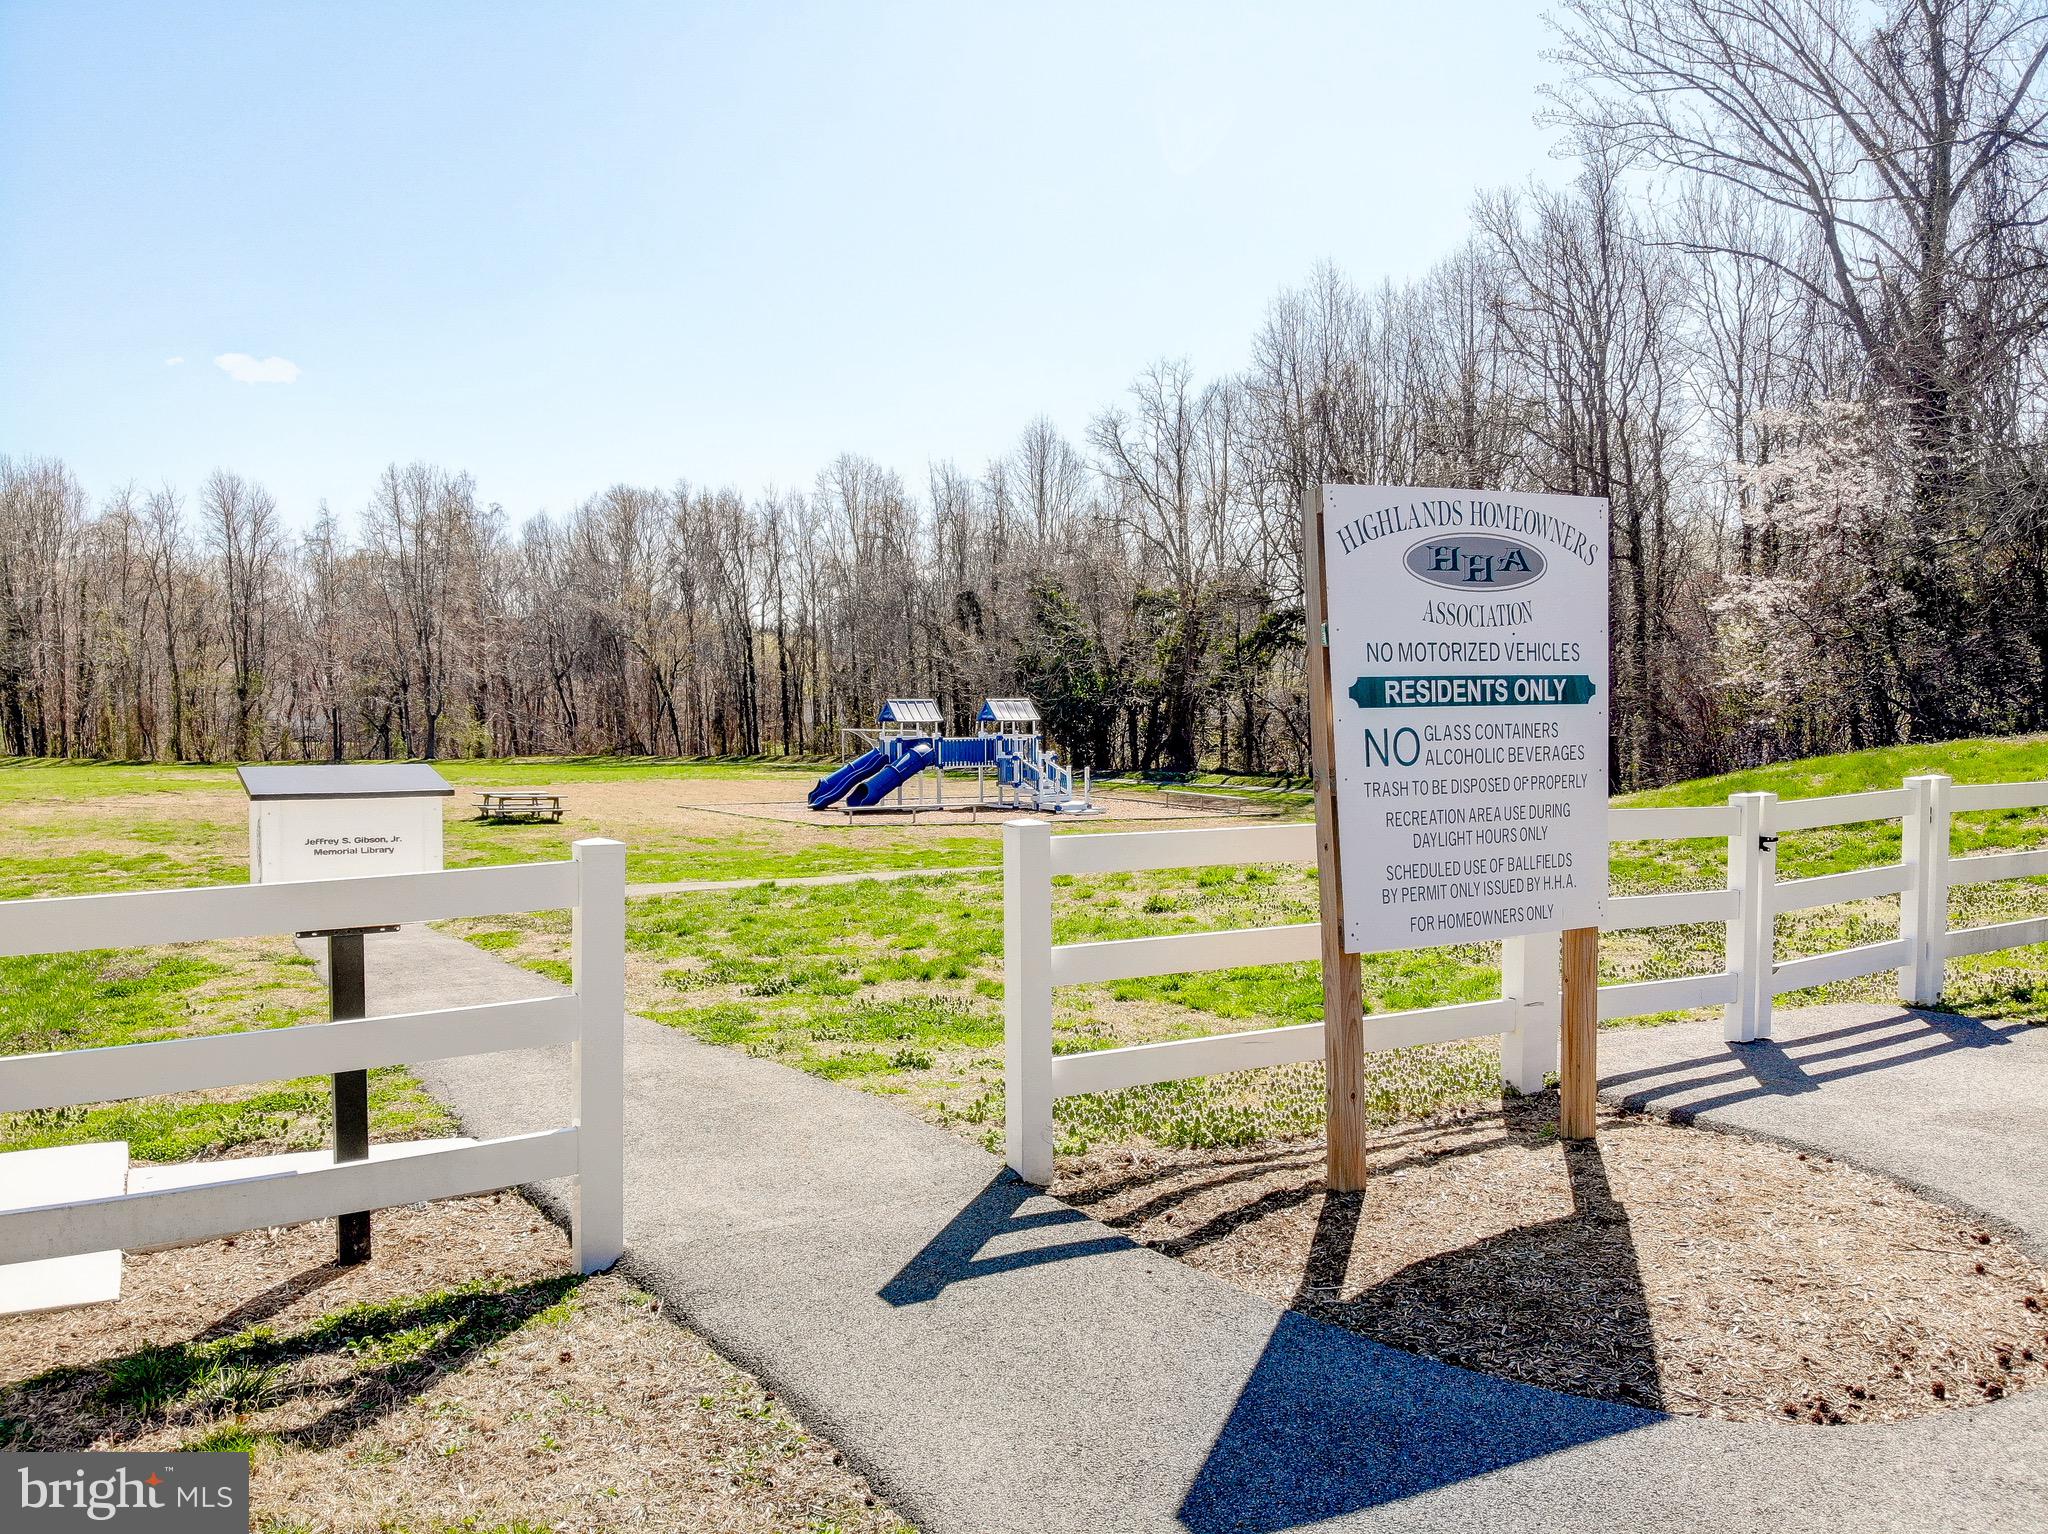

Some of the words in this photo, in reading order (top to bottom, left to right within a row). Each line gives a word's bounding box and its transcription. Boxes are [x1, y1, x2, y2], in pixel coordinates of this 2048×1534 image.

[1336, 500, 1463, 555] HIGHLANDS
[1471, 501, 1599, 566] HOMEOWNERS
[1423, 600, 1533, 627] ASSOCIATION
[1367, 643, 1393, 662] NO
[1400, 642, 1499, 662] MOTORIZED
[1505, 643, 1580, 661] VEHICLES
[1385, 680, 1508, 703] RESIDENTS
[1514, 679, 1567, 701] ONLY
[1424, 724, 1471, 741] GLASS
[1475, 722, 1558, 739] CONTAINERS
[1365, 727, 1420, 767] NO
[1425, 748, 1504, 766] ALCOHOLIC
[1508, 745, 1584, 763] BEVERAGES
[1364, 781, 1409, 798] TRASH
[1412, 780, 1429, 796] TO
[1432, 780, 1448, 795] BE
[1451, 777, 1510, 794] DISPOSED
[1514, 776, 1528, 791] OF
[1530, 774, 1588, 790] PROPERLY
[1386, 809, 1465, 827] RECREATION
[1469, 807, 1501, 822] AREA
[1504, 805, 1525, 820] USE
[1529, 803, 1570, 819] DURING
[305, 838, 339, 846] Jeffrey
[354, 836, 388, 844] Gibson,
[1413, 830, 1472, 849] DAYLIGHT
[1476, 828, 1517, 845] HOURS
[1520, 826, 1548, 842] ONLY
[313, 847, 358, 855] Memorial
[1386, 861, 1460, 881] SCHEDULED
[1464, 859, 1486, 874] USE
[1489, 858, 1504, 872] OF
[1507, 853, 1572, 871] BALLFIELDS
[1382, 889, 1399, 904] BY
[1402, 885, 1447, 902] PERMIT
[1450, 883, 1480, 899] ONLY
[1483, 879, 1524, 896] ISSUED
[1527, 877, 1540, 892] BY
[1543, 875, 1577, 890] H.H.A.
[1410, 916, 1435, 932] FOR
[1438, 907, 1524, 930] HOMEOWNERS
[1527, 904, 1554, 920] ONLY
